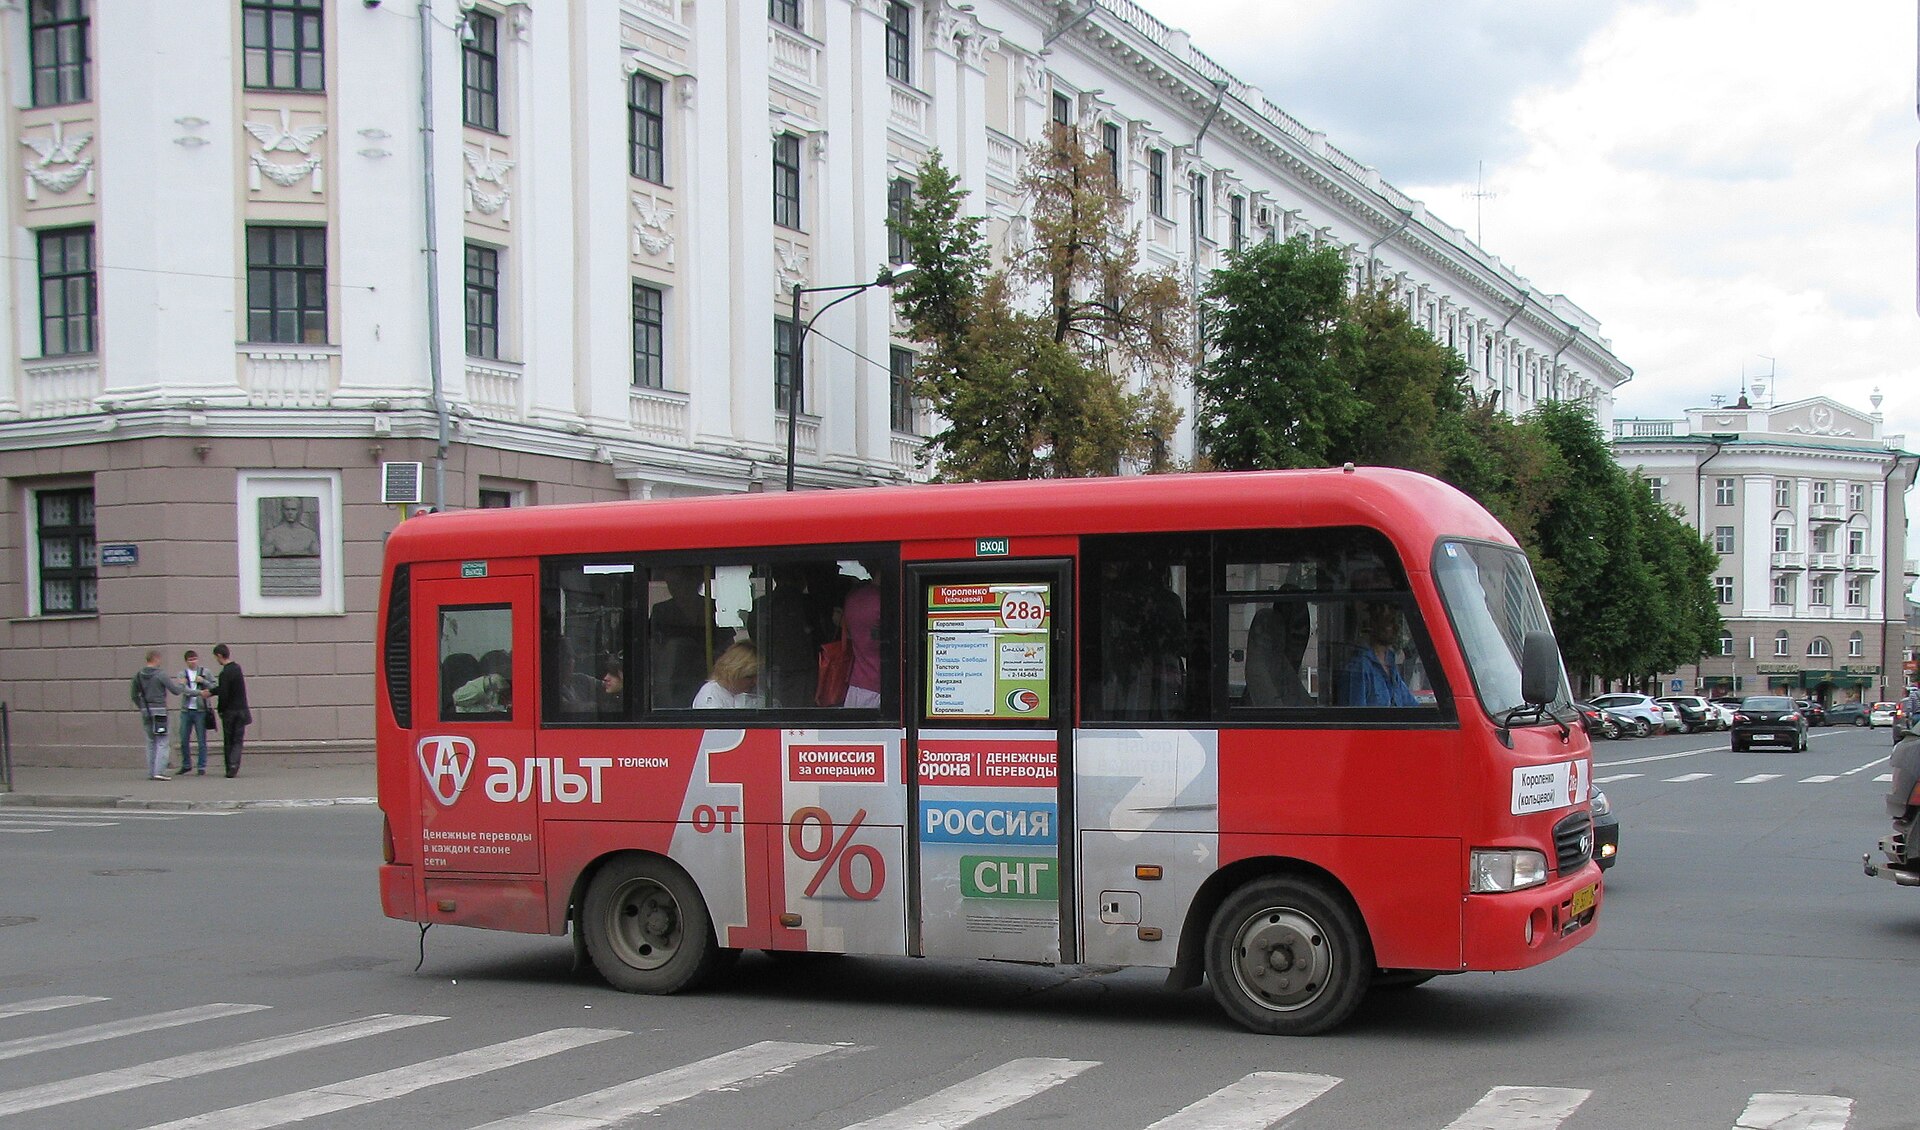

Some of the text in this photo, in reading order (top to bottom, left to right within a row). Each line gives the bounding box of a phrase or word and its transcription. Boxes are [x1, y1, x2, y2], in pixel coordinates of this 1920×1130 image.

[980, 541, 1005, 553] ВХОД
[941, 587, 987, 597] Короленко
[1005, 602, 1041, 619] 28а
[923, 750, 970, 762] Золотая
[986, 753, 1057, 764] ДЕНЕЖНЫЕ
[617, 757, 669, 768] телеком
[798, 767, 875, 778] за операцию
[918, 763, 970, 779] орона
[986, 766, 1057, 778] ПЕРЕВОДЫ
[1521, 773, 1555, 788] Короленко
[926, 808, 1050, 836] РОССИЯ
[479, 832, 532, 843] переводы
[431, 844, 471, 855] каждом
[473, 845, 511, 855] салоне
[789, 806, 886, 901] %
[424, 857, 447, 866] сети
[974, 861, 1049, 895] СНГ
